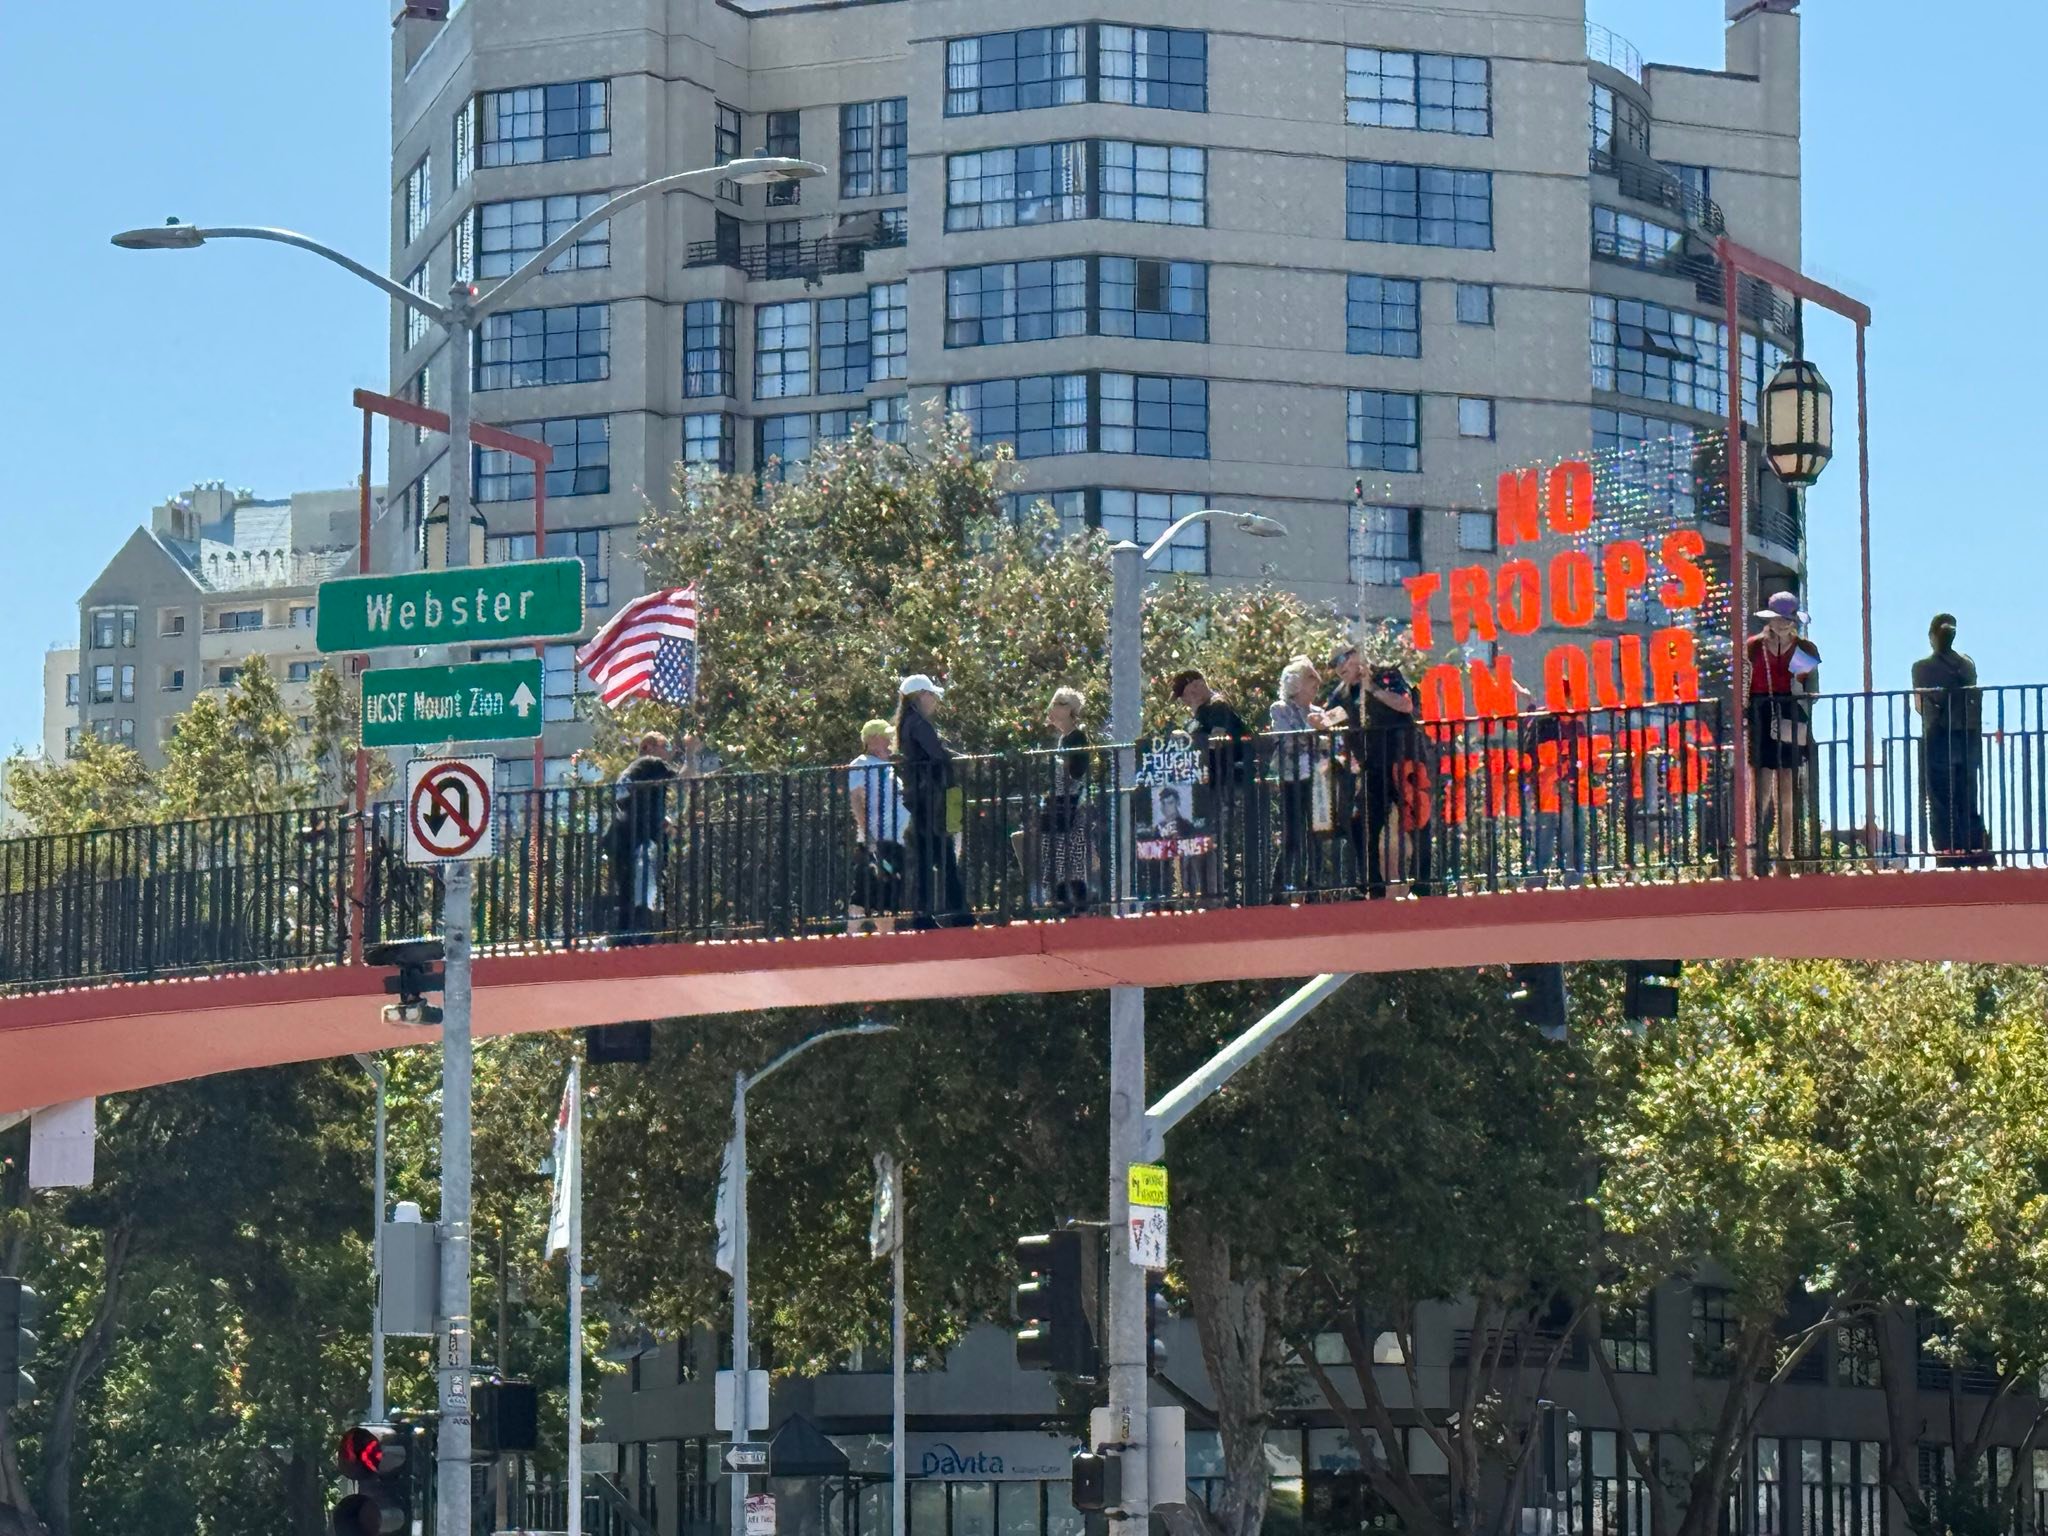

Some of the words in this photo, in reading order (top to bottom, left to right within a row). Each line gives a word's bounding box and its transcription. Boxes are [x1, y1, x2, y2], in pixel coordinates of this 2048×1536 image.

[1497, 460, 1593, 546] NO
[366, 588, 534, 632] Webster
[1403, 530, 1706, 649] TROOPS
[367, 691, 407, 724] UCSF
[414, 690, 462, 721] Mount
[469, 688, 503, 717] Zion
[1420, 655, 1518, 742] ON
[1544, 627, 1699, 722] OUR
